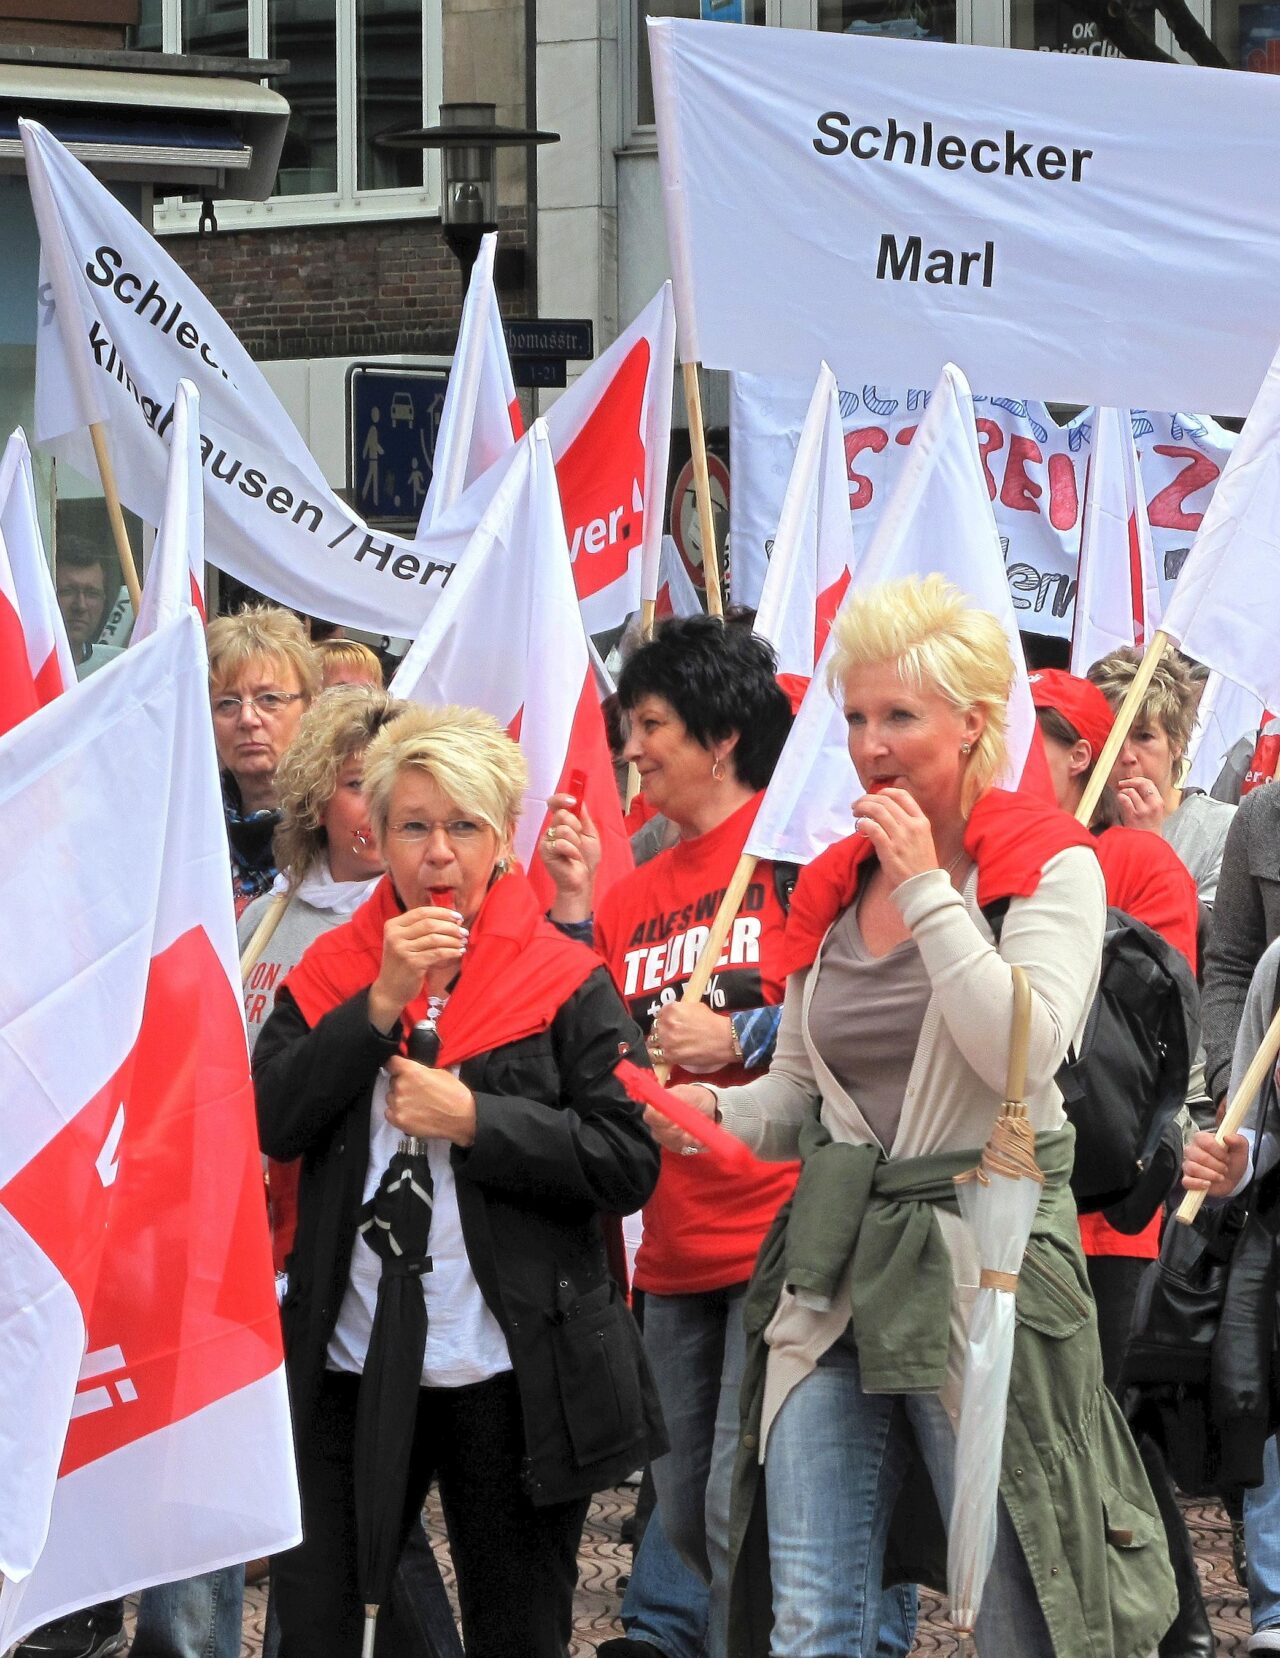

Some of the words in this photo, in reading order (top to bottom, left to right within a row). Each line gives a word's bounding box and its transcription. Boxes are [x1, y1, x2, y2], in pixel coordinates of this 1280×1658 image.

[1072, 22, 1095, 39] OK
[813, 111, 1093, 182] Schlecker
[876, 233, 994, 287] Marl
[504, 329, 583, 353] homasstr.
[629, 902, 694, 947] ALLES
